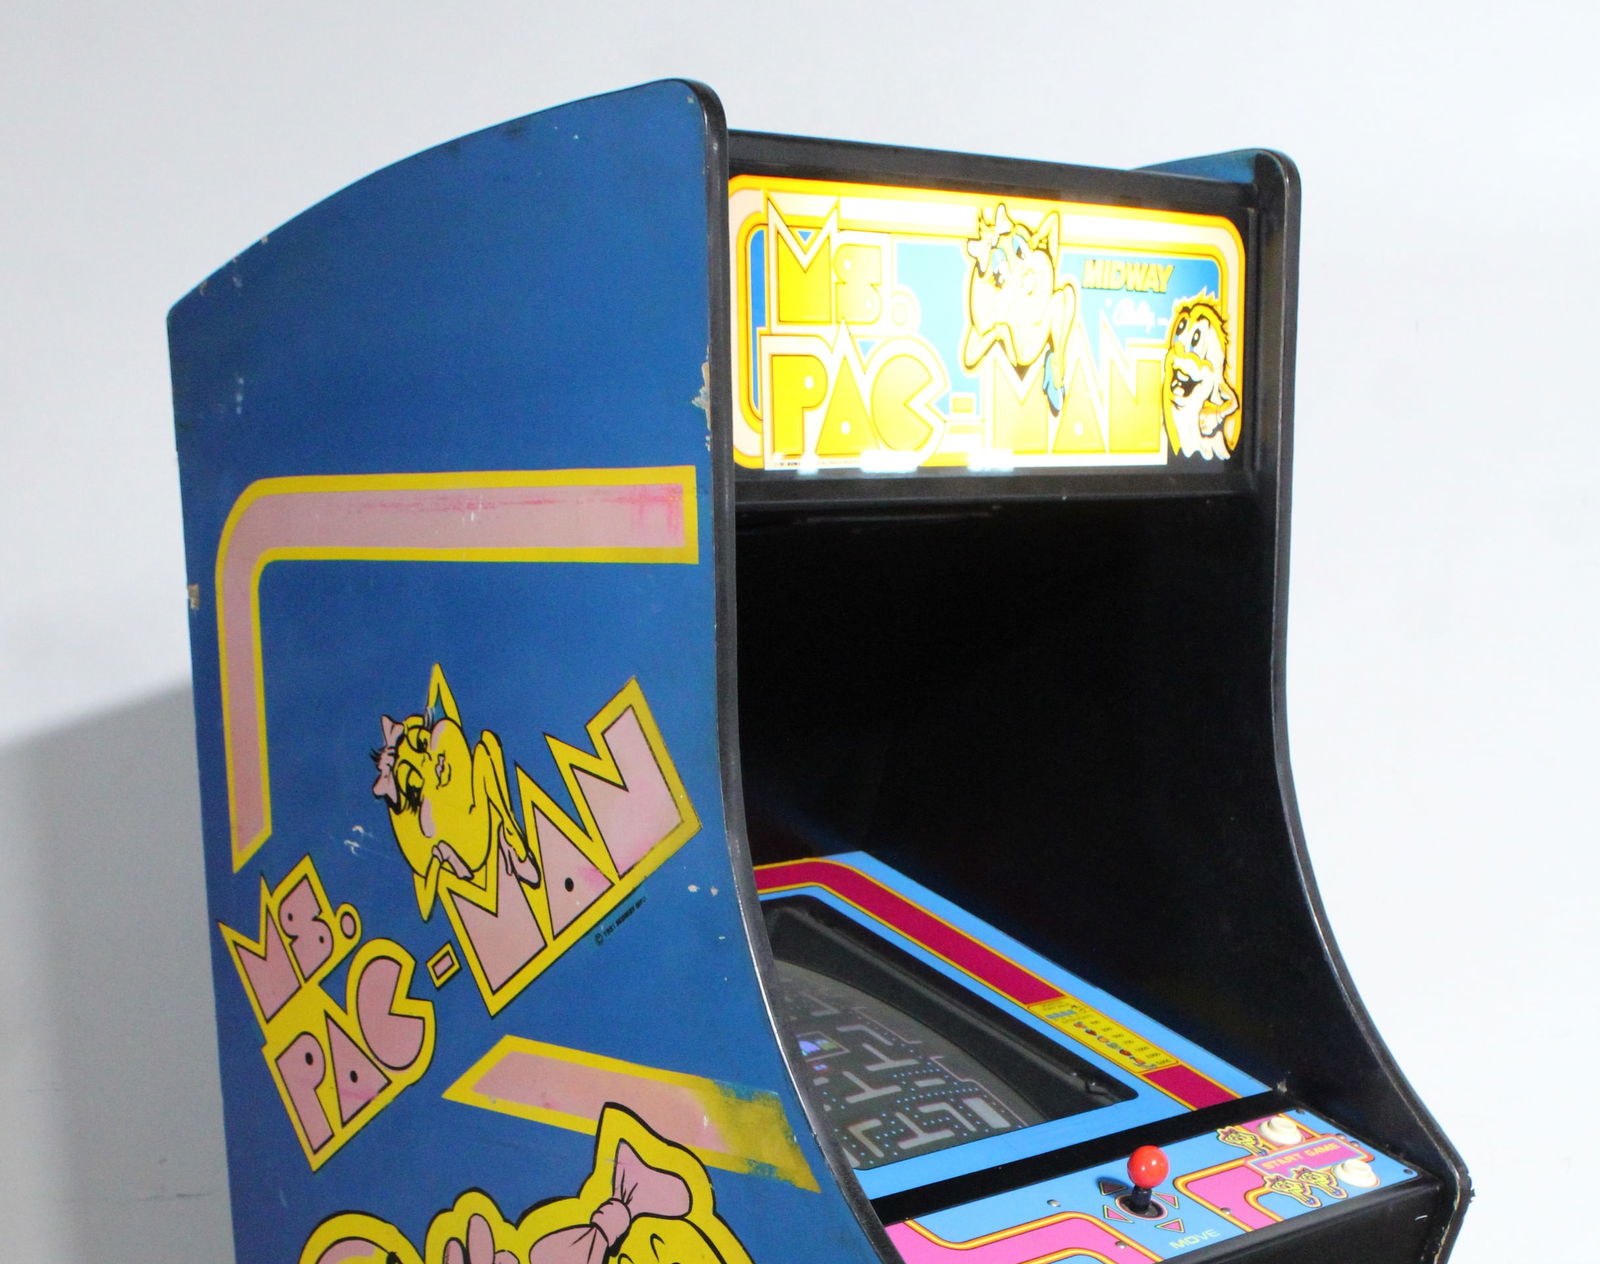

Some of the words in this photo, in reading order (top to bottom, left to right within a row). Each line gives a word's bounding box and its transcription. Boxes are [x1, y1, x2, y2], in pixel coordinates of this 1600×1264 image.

[765, 194, 919, 336] MS.
[1082, 259, 1174, 294] MIDWAY
[761, 318, 1167, 468] PAC-MAN
[218, 854, 361, 1026] MS.
[261, 676, 702, 1172] PAC-MAN
[1261, 1152, 1304, 1170] START
[1303, 1142, 1342, 1158] GAME
[1168, 1228, 1221, 1250] MOVE
